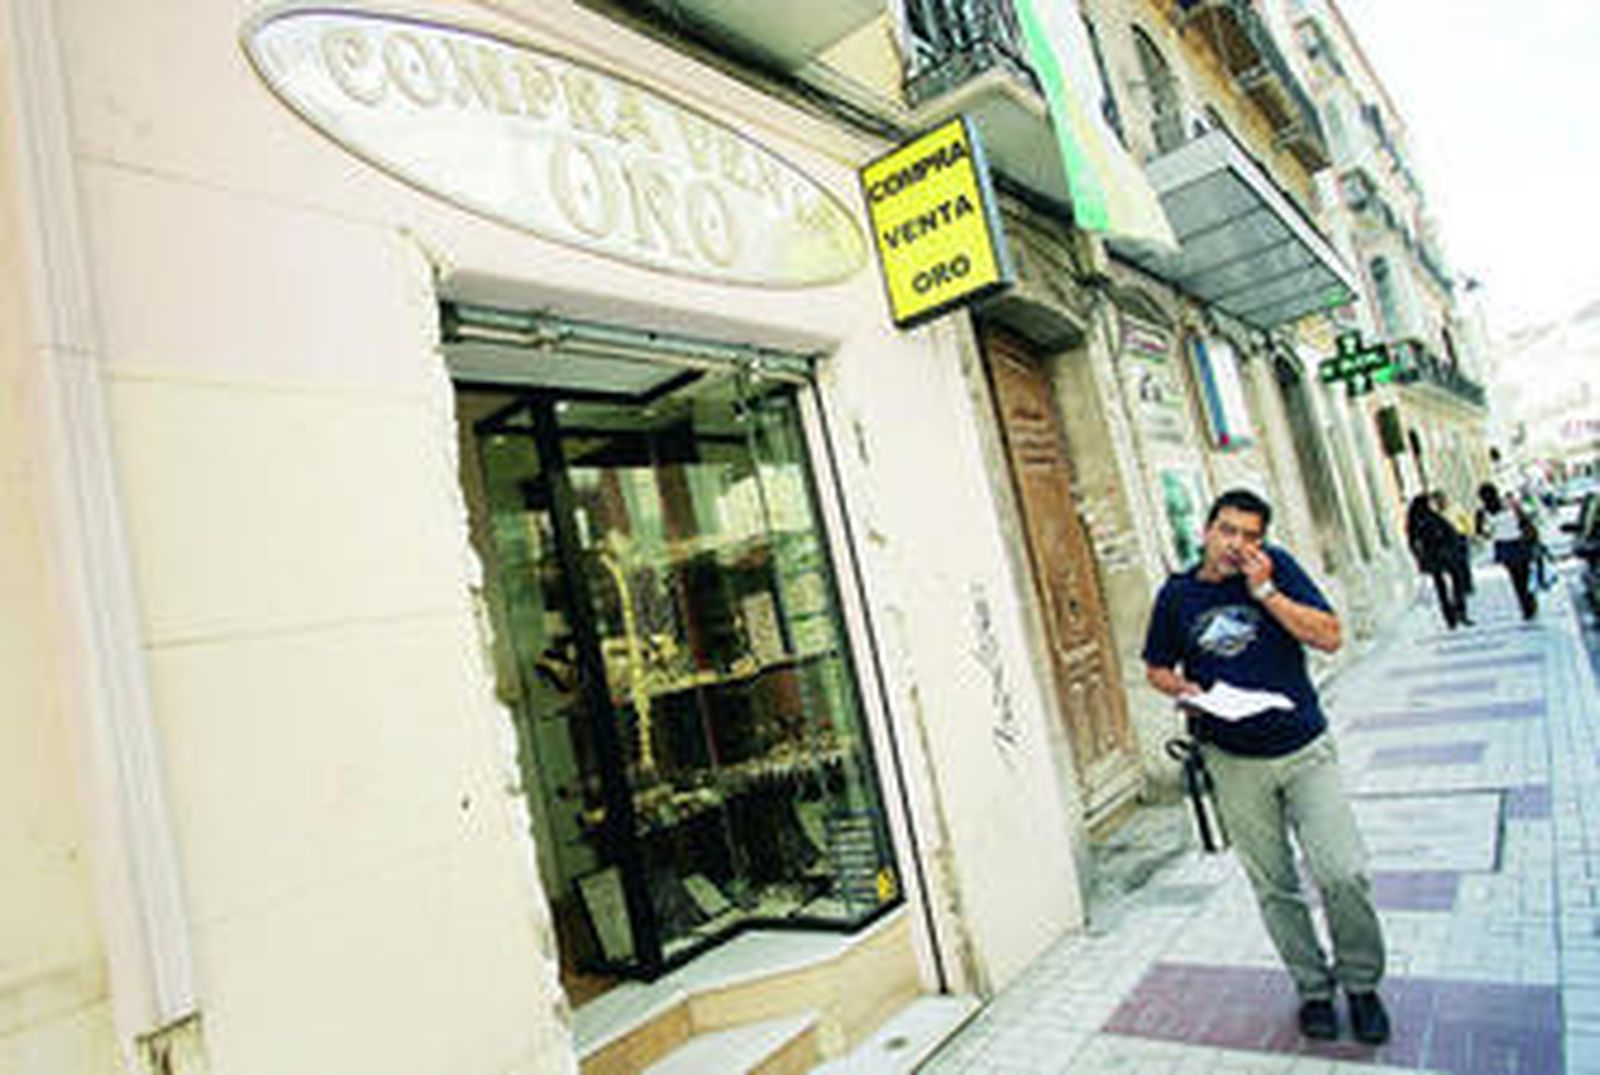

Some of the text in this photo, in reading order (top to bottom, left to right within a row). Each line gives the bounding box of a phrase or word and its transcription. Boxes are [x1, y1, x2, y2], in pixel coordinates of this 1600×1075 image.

[320, 27, 664, 154] COMPRA
[549, 136, 735, 269] ORO
[867, 139, 967, 203] COMPRA
[882, 194, 974, 249] VENTA
[911, 254, 971, 294] ORO
